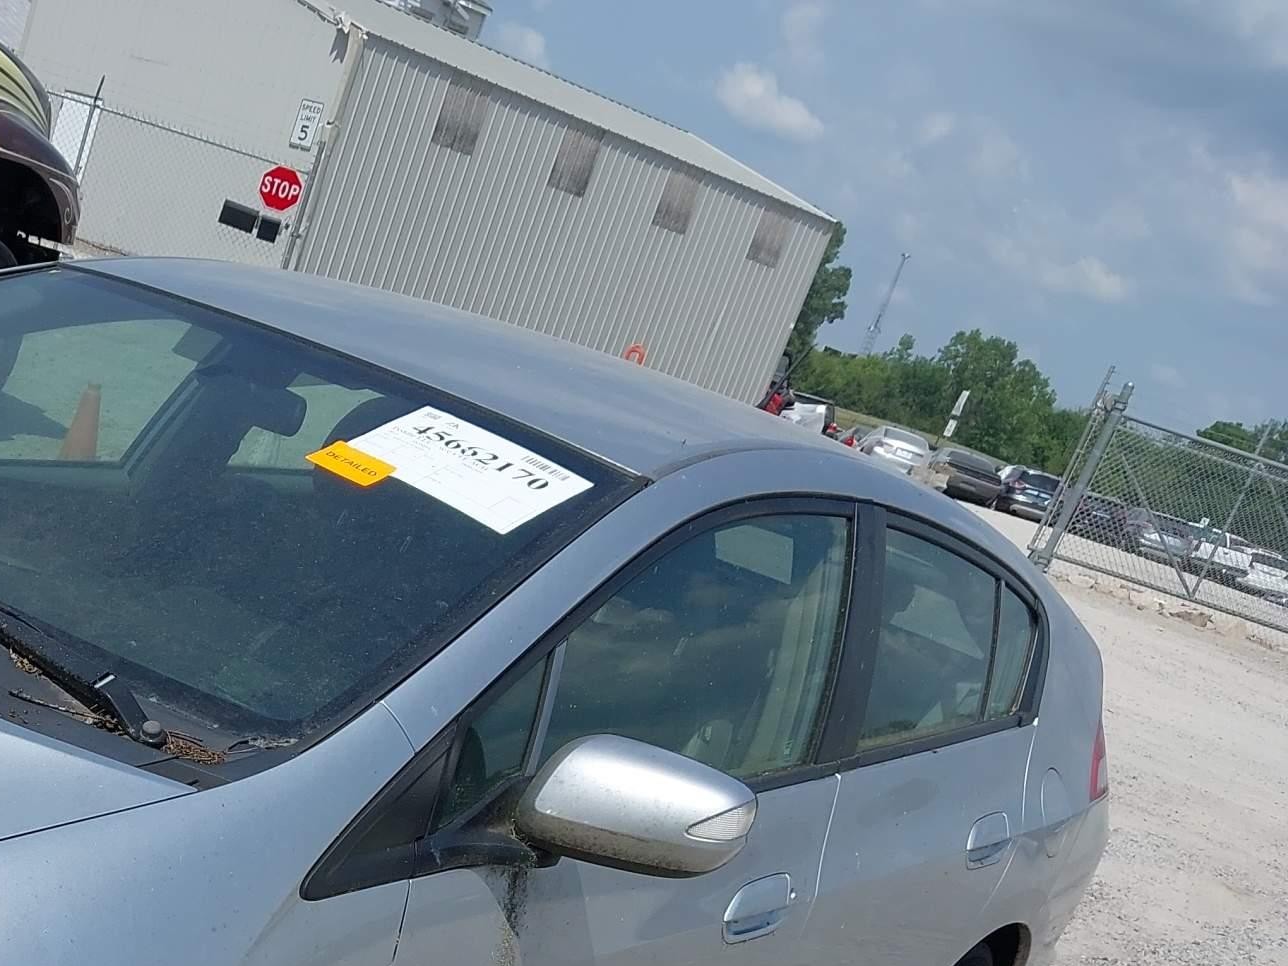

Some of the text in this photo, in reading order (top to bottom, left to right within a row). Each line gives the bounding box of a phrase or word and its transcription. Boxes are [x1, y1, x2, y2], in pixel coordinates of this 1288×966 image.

[302, 103, 321, 114] SPEED
[300, 114, 317, 123] LIMIT
[298, 124, 309, 141] 5
[261, 176, 300, 201] STOP
[325, 450, 378, 477] DETAILED
